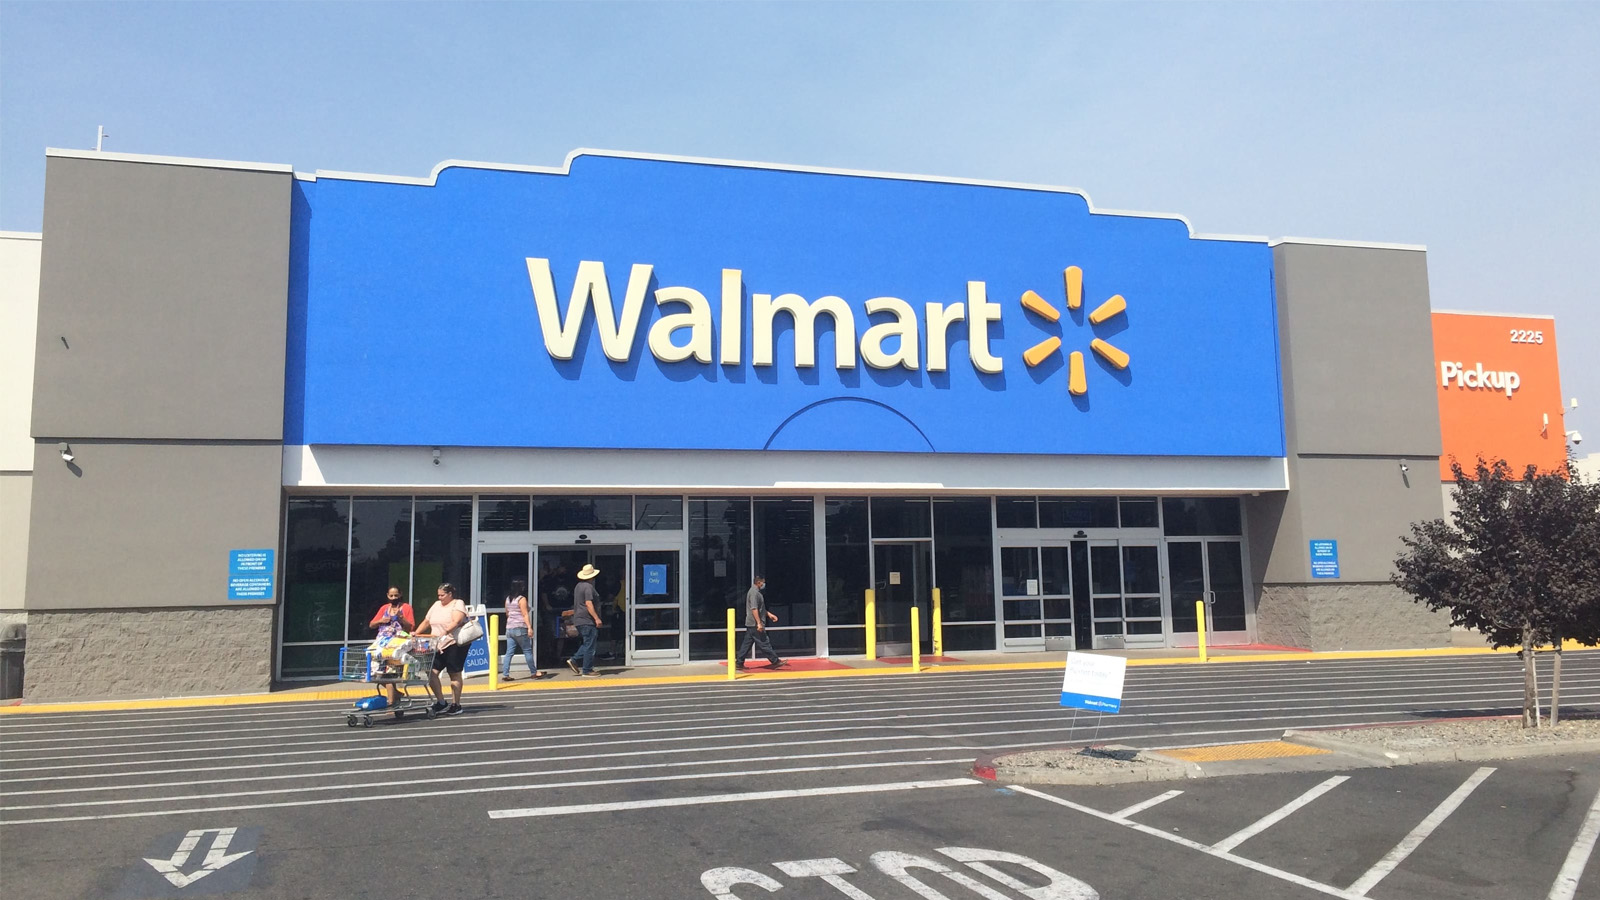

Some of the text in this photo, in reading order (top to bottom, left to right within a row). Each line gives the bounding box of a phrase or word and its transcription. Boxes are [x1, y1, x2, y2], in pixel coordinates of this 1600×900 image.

[526, 257, 1002, 374] Walmart
[1510, 329, 1543, 344] 2225
[1441, 361, 1520, 396] Pickup
[468, 648, 484, 656] SOLO
[467, 658, 488, 667] SALIDA
